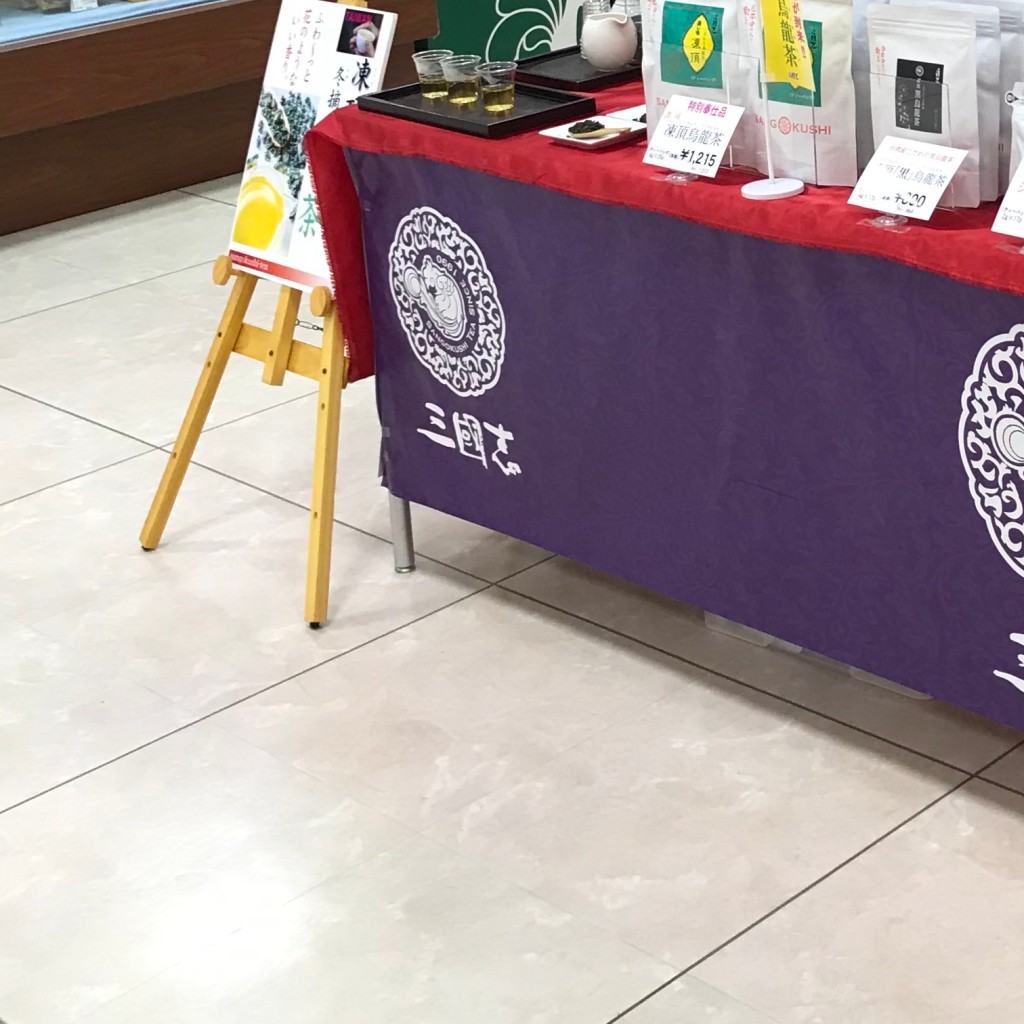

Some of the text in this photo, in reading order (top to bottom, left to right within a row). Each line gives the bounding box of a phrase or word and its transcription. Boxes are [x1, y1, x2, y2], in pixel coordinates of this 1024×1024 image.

[664, 124, 725, 147] 凍頂烏龍茶
[680, 148, 717, 167] ¥1,215
